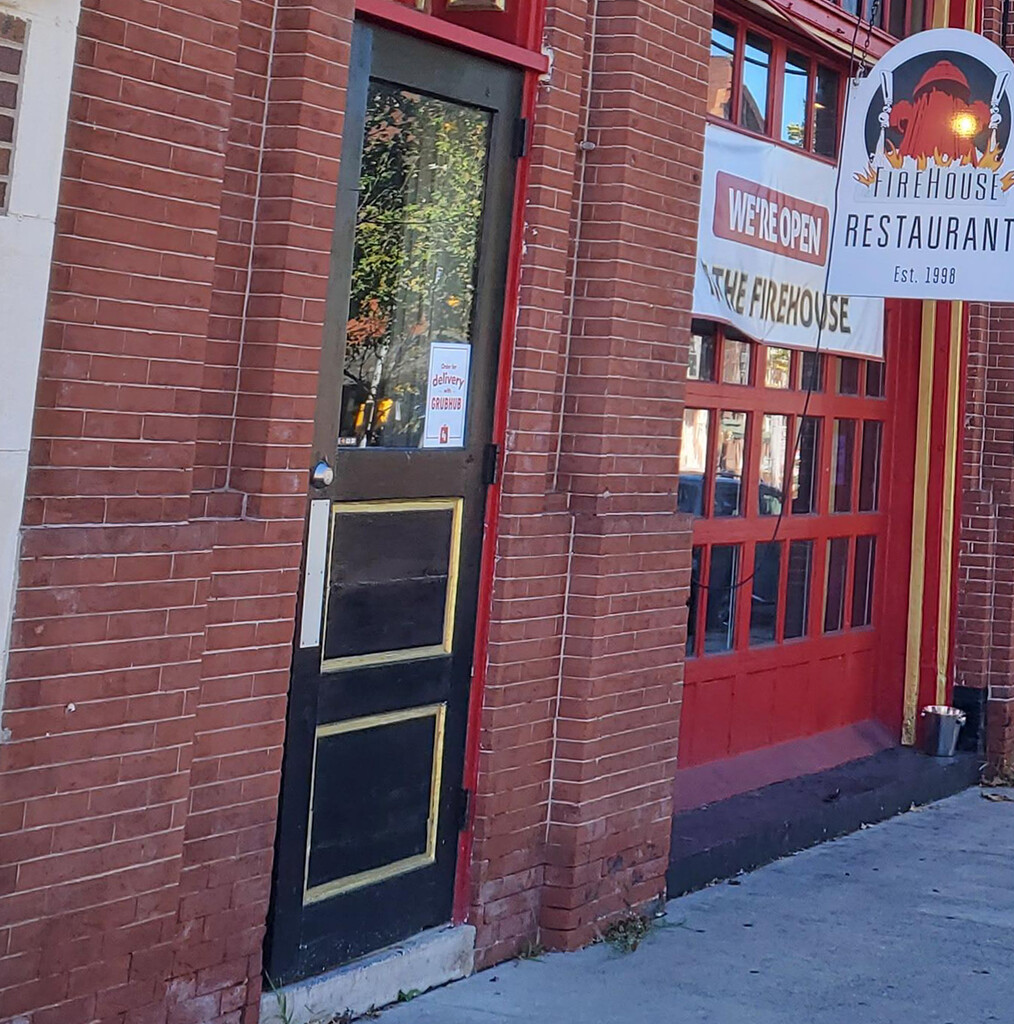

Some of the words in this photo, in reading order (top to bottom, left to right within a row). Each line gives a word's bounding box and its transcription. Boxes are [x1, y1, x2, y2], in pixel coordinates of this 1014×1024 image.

[874, 166, 1000, 200] FIREHOUSE
[728, 187, 778, 244] WE'RE
[780, 206, 822, 256] OPEN
[844, 213, 1014, 252] RESTAURANT
[893, 265, 918, 283] Est.
[925, 266, 956, 284] 1998
[749, 276, 851, 334] FIREHOUSE
[432, 372, 465, 390] delivery
[431, 397, 462, 410] GRUBHUB
